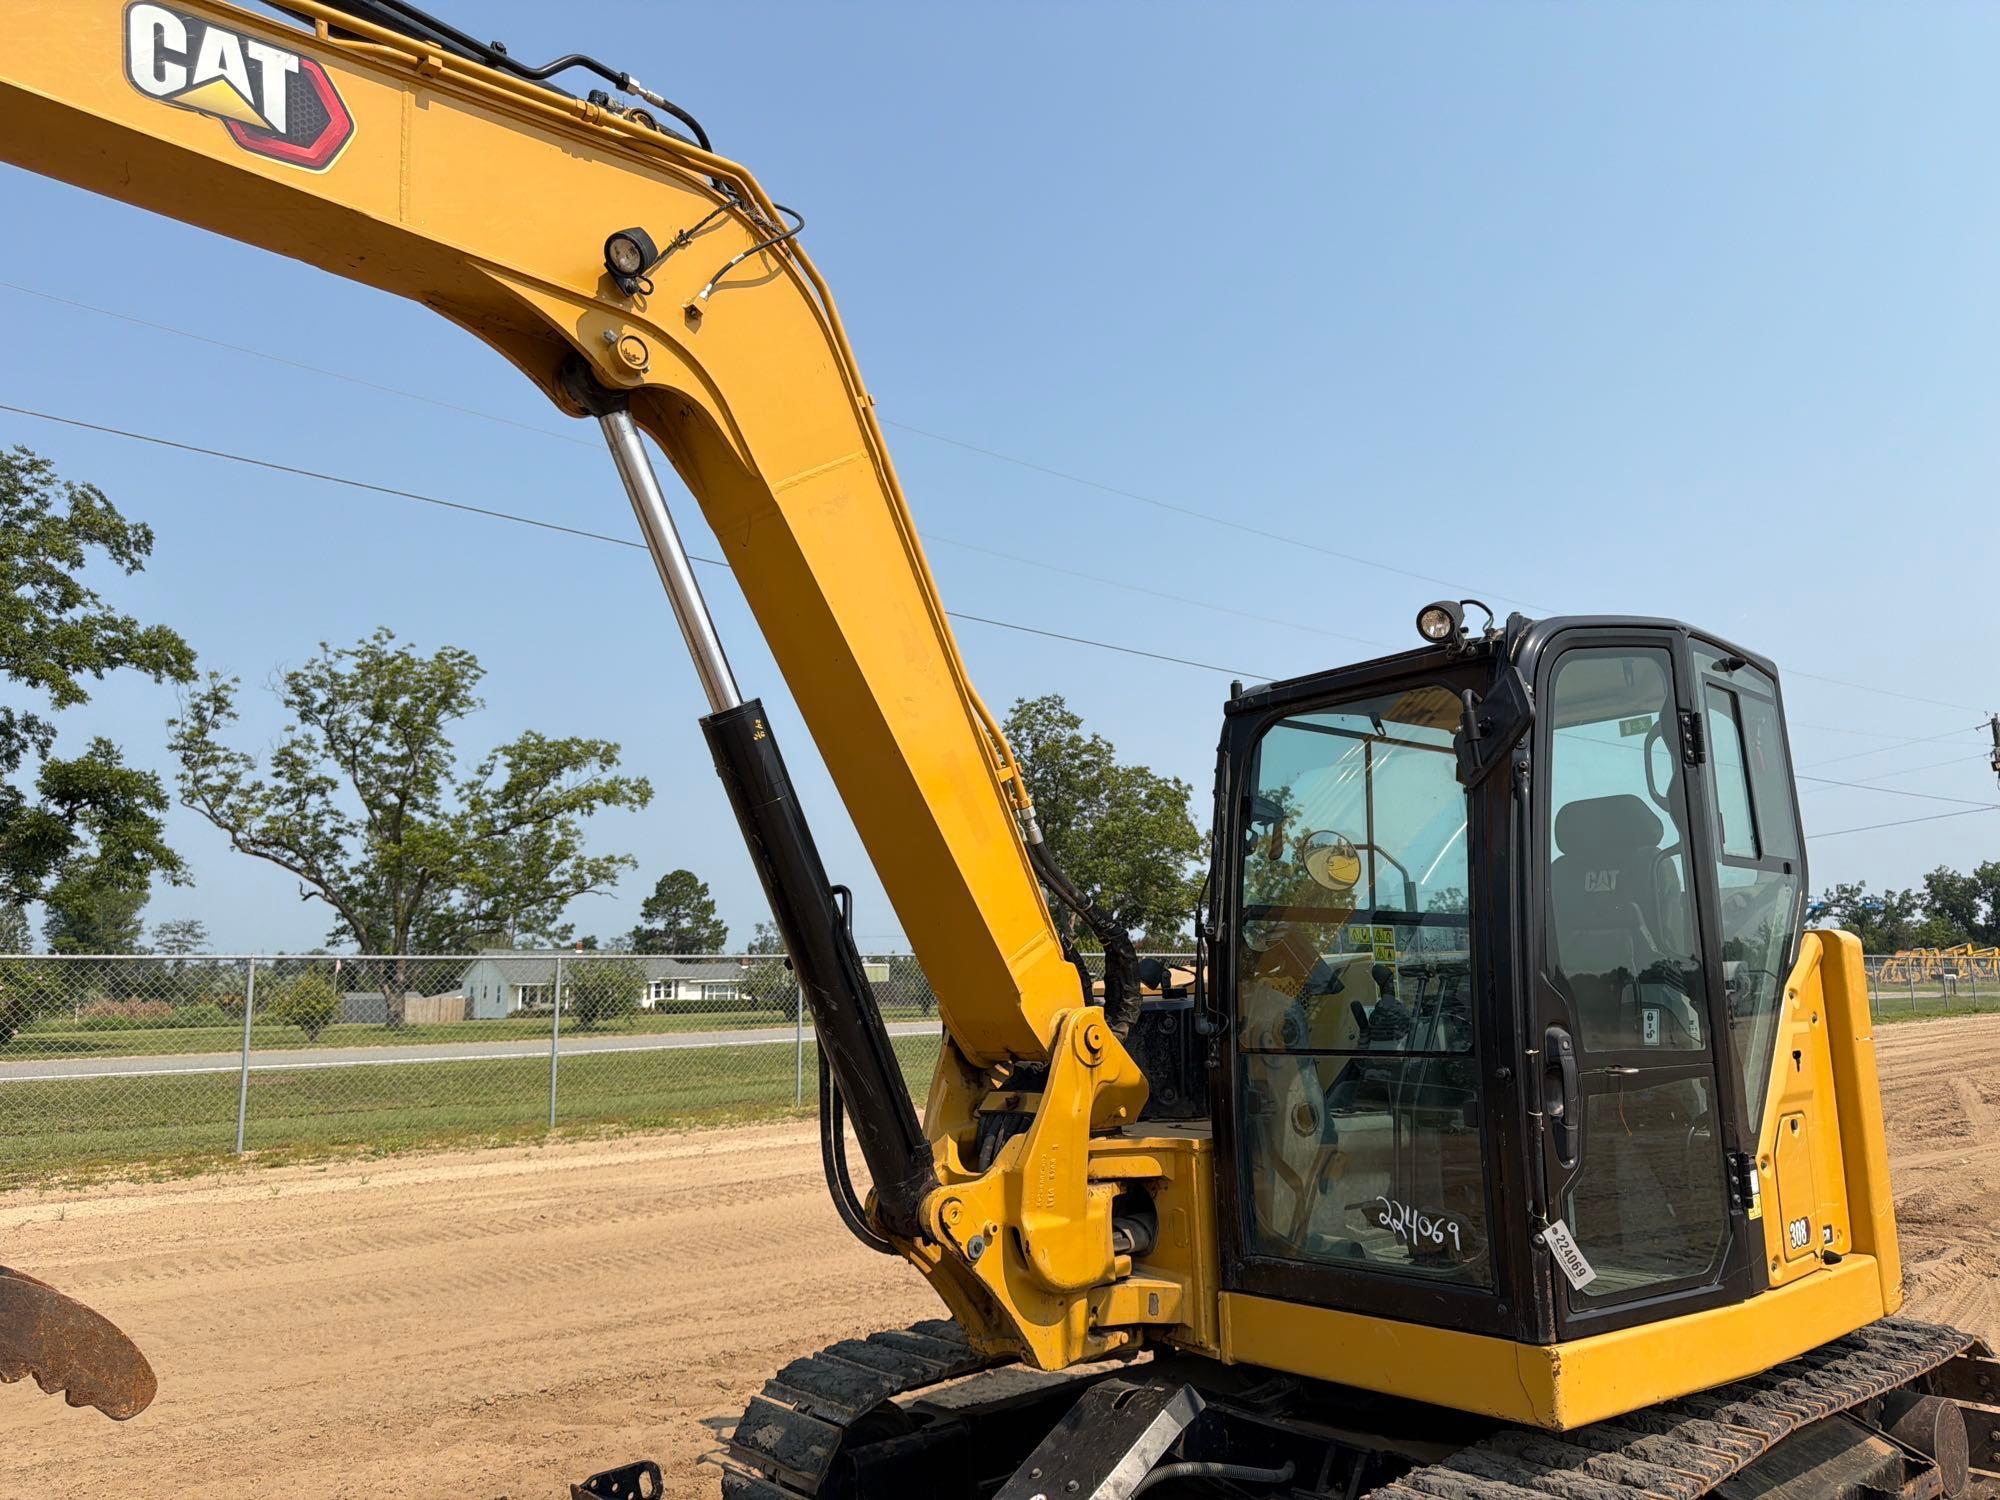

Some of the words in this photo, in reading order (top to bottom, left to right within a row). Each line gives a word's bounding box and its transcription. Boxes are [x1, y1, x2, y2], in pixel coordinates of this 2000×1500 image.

[129, 4, 299, 134] CAT
[1584, 869, 1620, 893] CAT
[1376, 1195, 1461, 1251] 224069
[1789, 1218, 1807, 1248] 308
[1555, 1233, 1587, 1279] 224069
